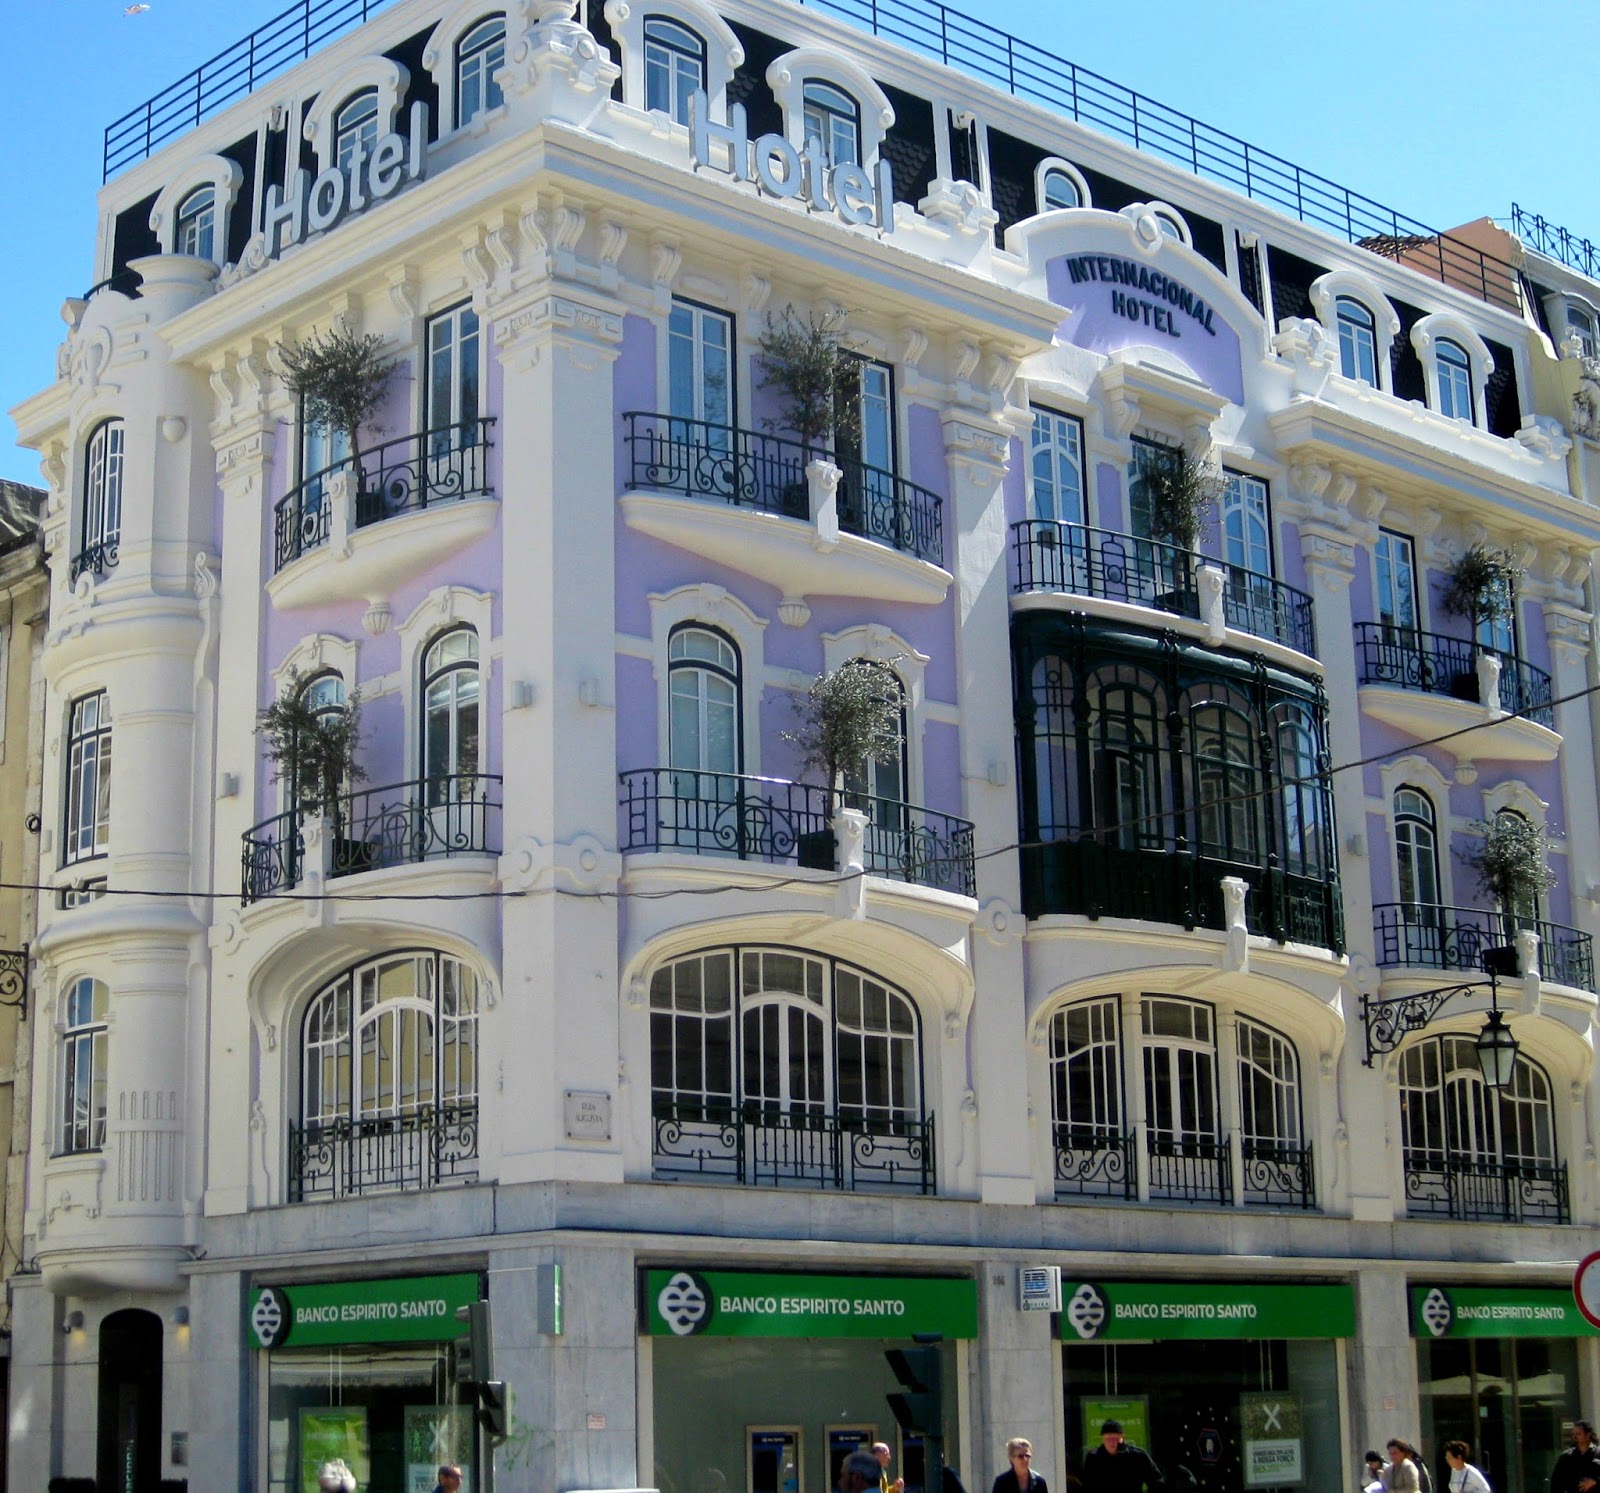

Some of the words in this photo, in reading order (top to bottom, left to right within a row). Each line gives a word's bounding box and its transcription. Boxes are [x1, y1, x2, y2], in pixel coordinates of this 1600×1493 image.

[264, 100, 428, 258] Hotel
[688, 88, 895, 234] Hotel
[1066, 256, 1217, 337] INTERNACIONAL
[1111, 289, 1181, 338] HOTEL
[296, 1306, 338, 1323] BANCO
[341, 1303, 397, 1321] ESPIRITO
[401, 1300, 446, 1318] SANTO
[720, 1296, 777, 1313] BANCO
[780, 1298, 850, 1314] ESPIRITO
[853, 1300, 905, 1315] SANTO
[1115, 1304, 1158, 1318] BANCO
[1161, 1304, 1215, 1318] ESPIRITO
[1217, 1304, 1257, 1318] SANTO
[1457, 1306, 1491, 1319] BANCO
[1491, 1306, 1533, 1319] ESPIRITO
[1534, 1307, 1565, 1319] SANTO
